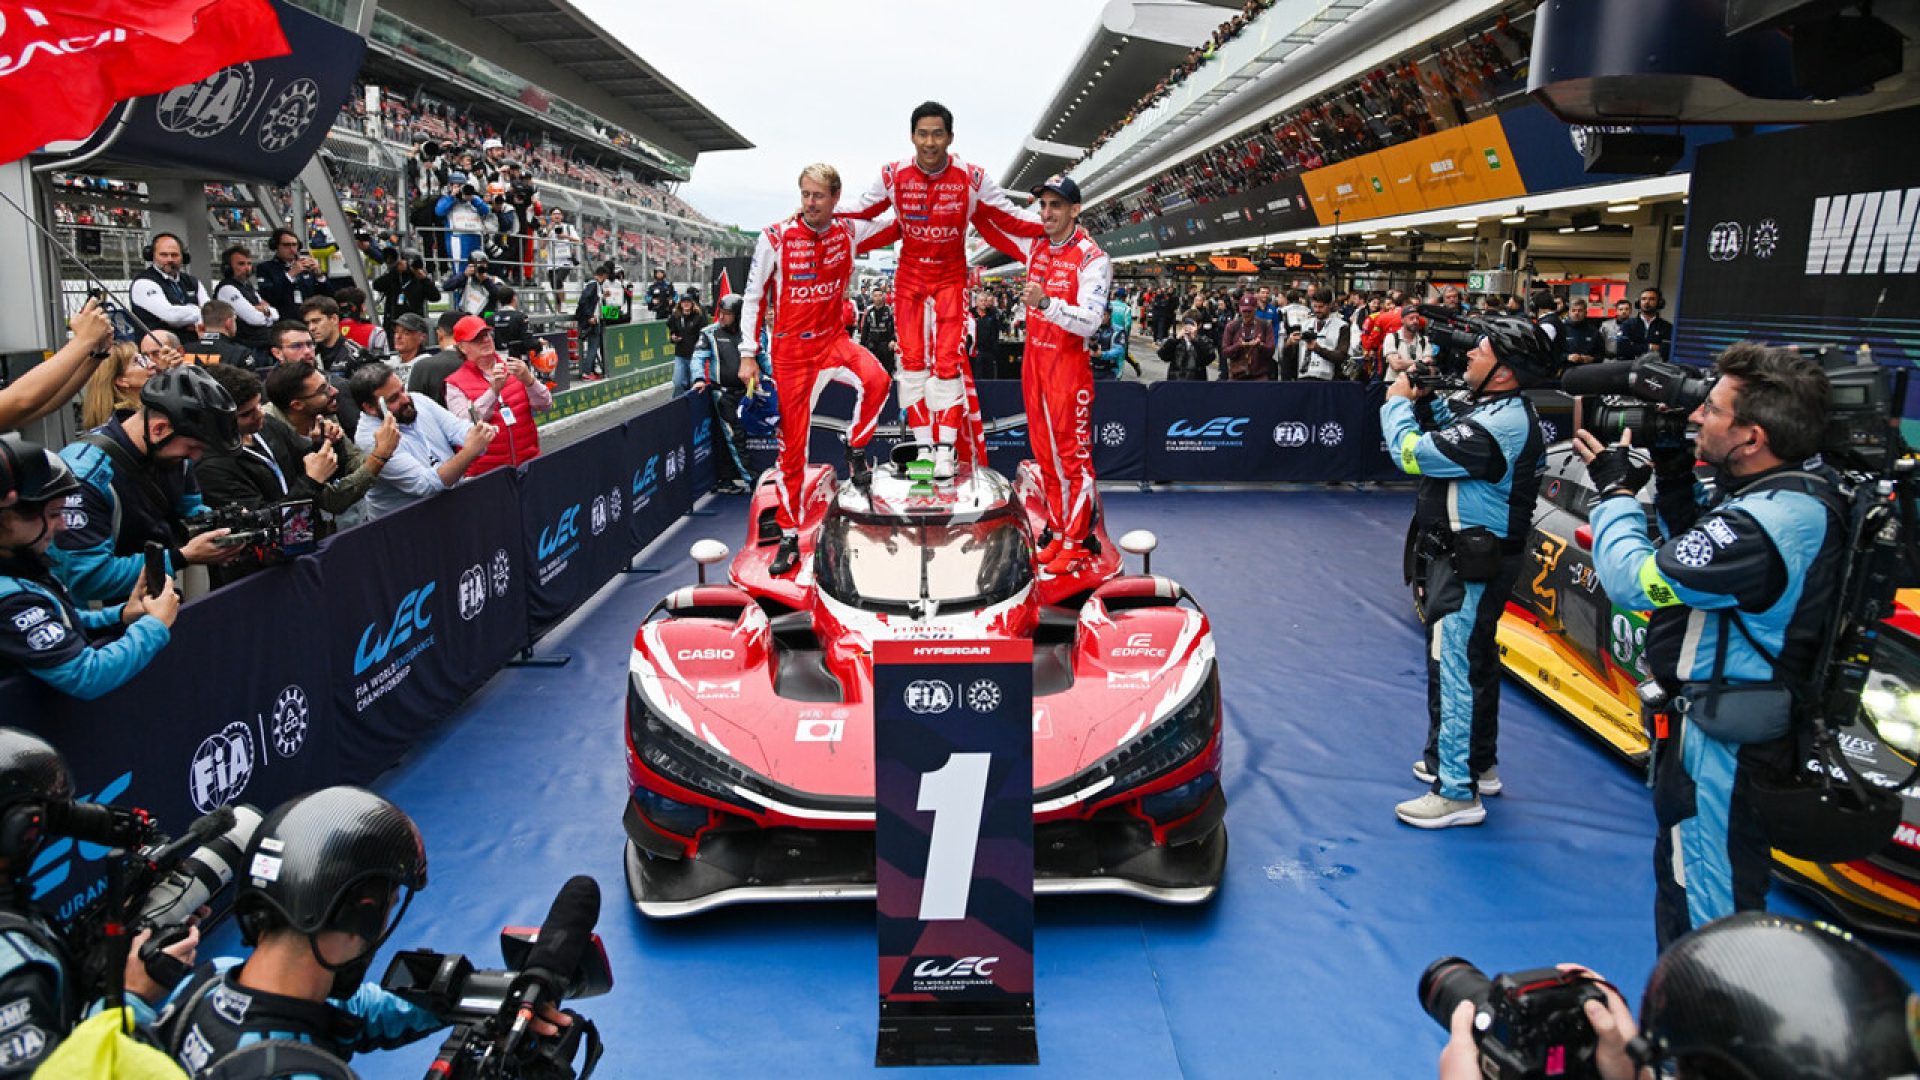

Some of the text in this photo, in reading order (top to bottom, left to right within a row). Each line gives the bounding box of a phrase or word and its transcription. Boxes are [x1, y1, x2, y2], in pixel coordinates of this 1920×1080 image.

[905, 223, 959, 238] TOYOTA
[1805, 187, 1920, 274] WIN
[1284, 253, 1302, 267] 58
[791, 279, 840, 297] TOYOTA
[1076, 389, 1091, 459] DENSO
[1167, 417, 1250, 437] WEC
[64, 495, 83, 507] MP
[538, 503, 580, 560] WEC
[354, 580, 436, 676] WEC
[677, 649, 736, 660] CASIO
[913, 647, 991, 655] HYPERCAR
[1111, 647, 1168, 657] EDIFICE
[916, 752, 992, 921] 1
[913, 956, 999, 977] WEC
